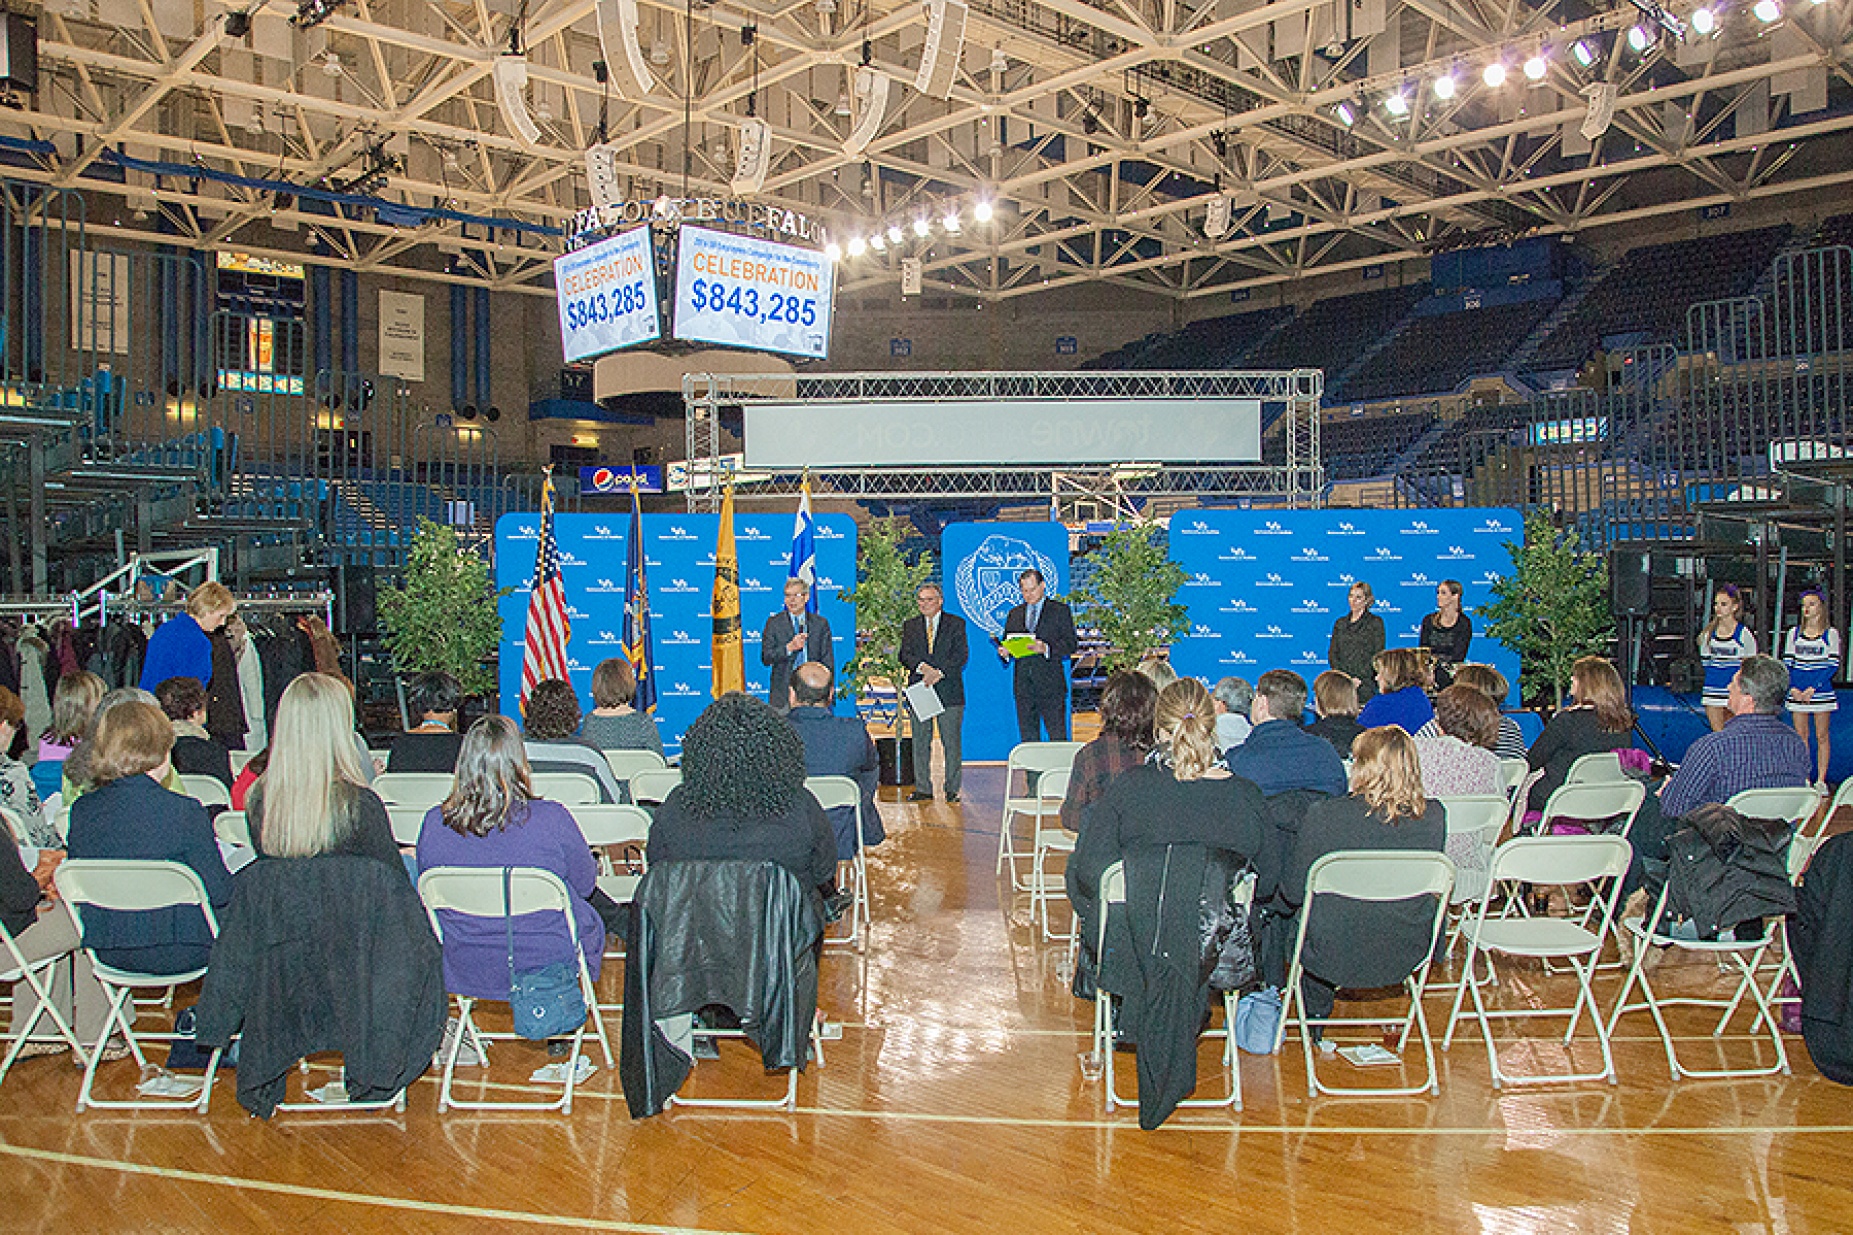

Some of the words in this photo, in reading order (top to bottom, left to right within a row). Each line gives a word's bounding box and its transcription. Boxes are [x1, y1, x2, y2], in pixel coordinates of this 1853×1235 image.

[564, 253, 643, 296] CELEBRATION
[693, 252, 818, 291] CELEBRATION
[567, 280, 645, 330] $843,285
[692, 278, 816, 326] $843,285
